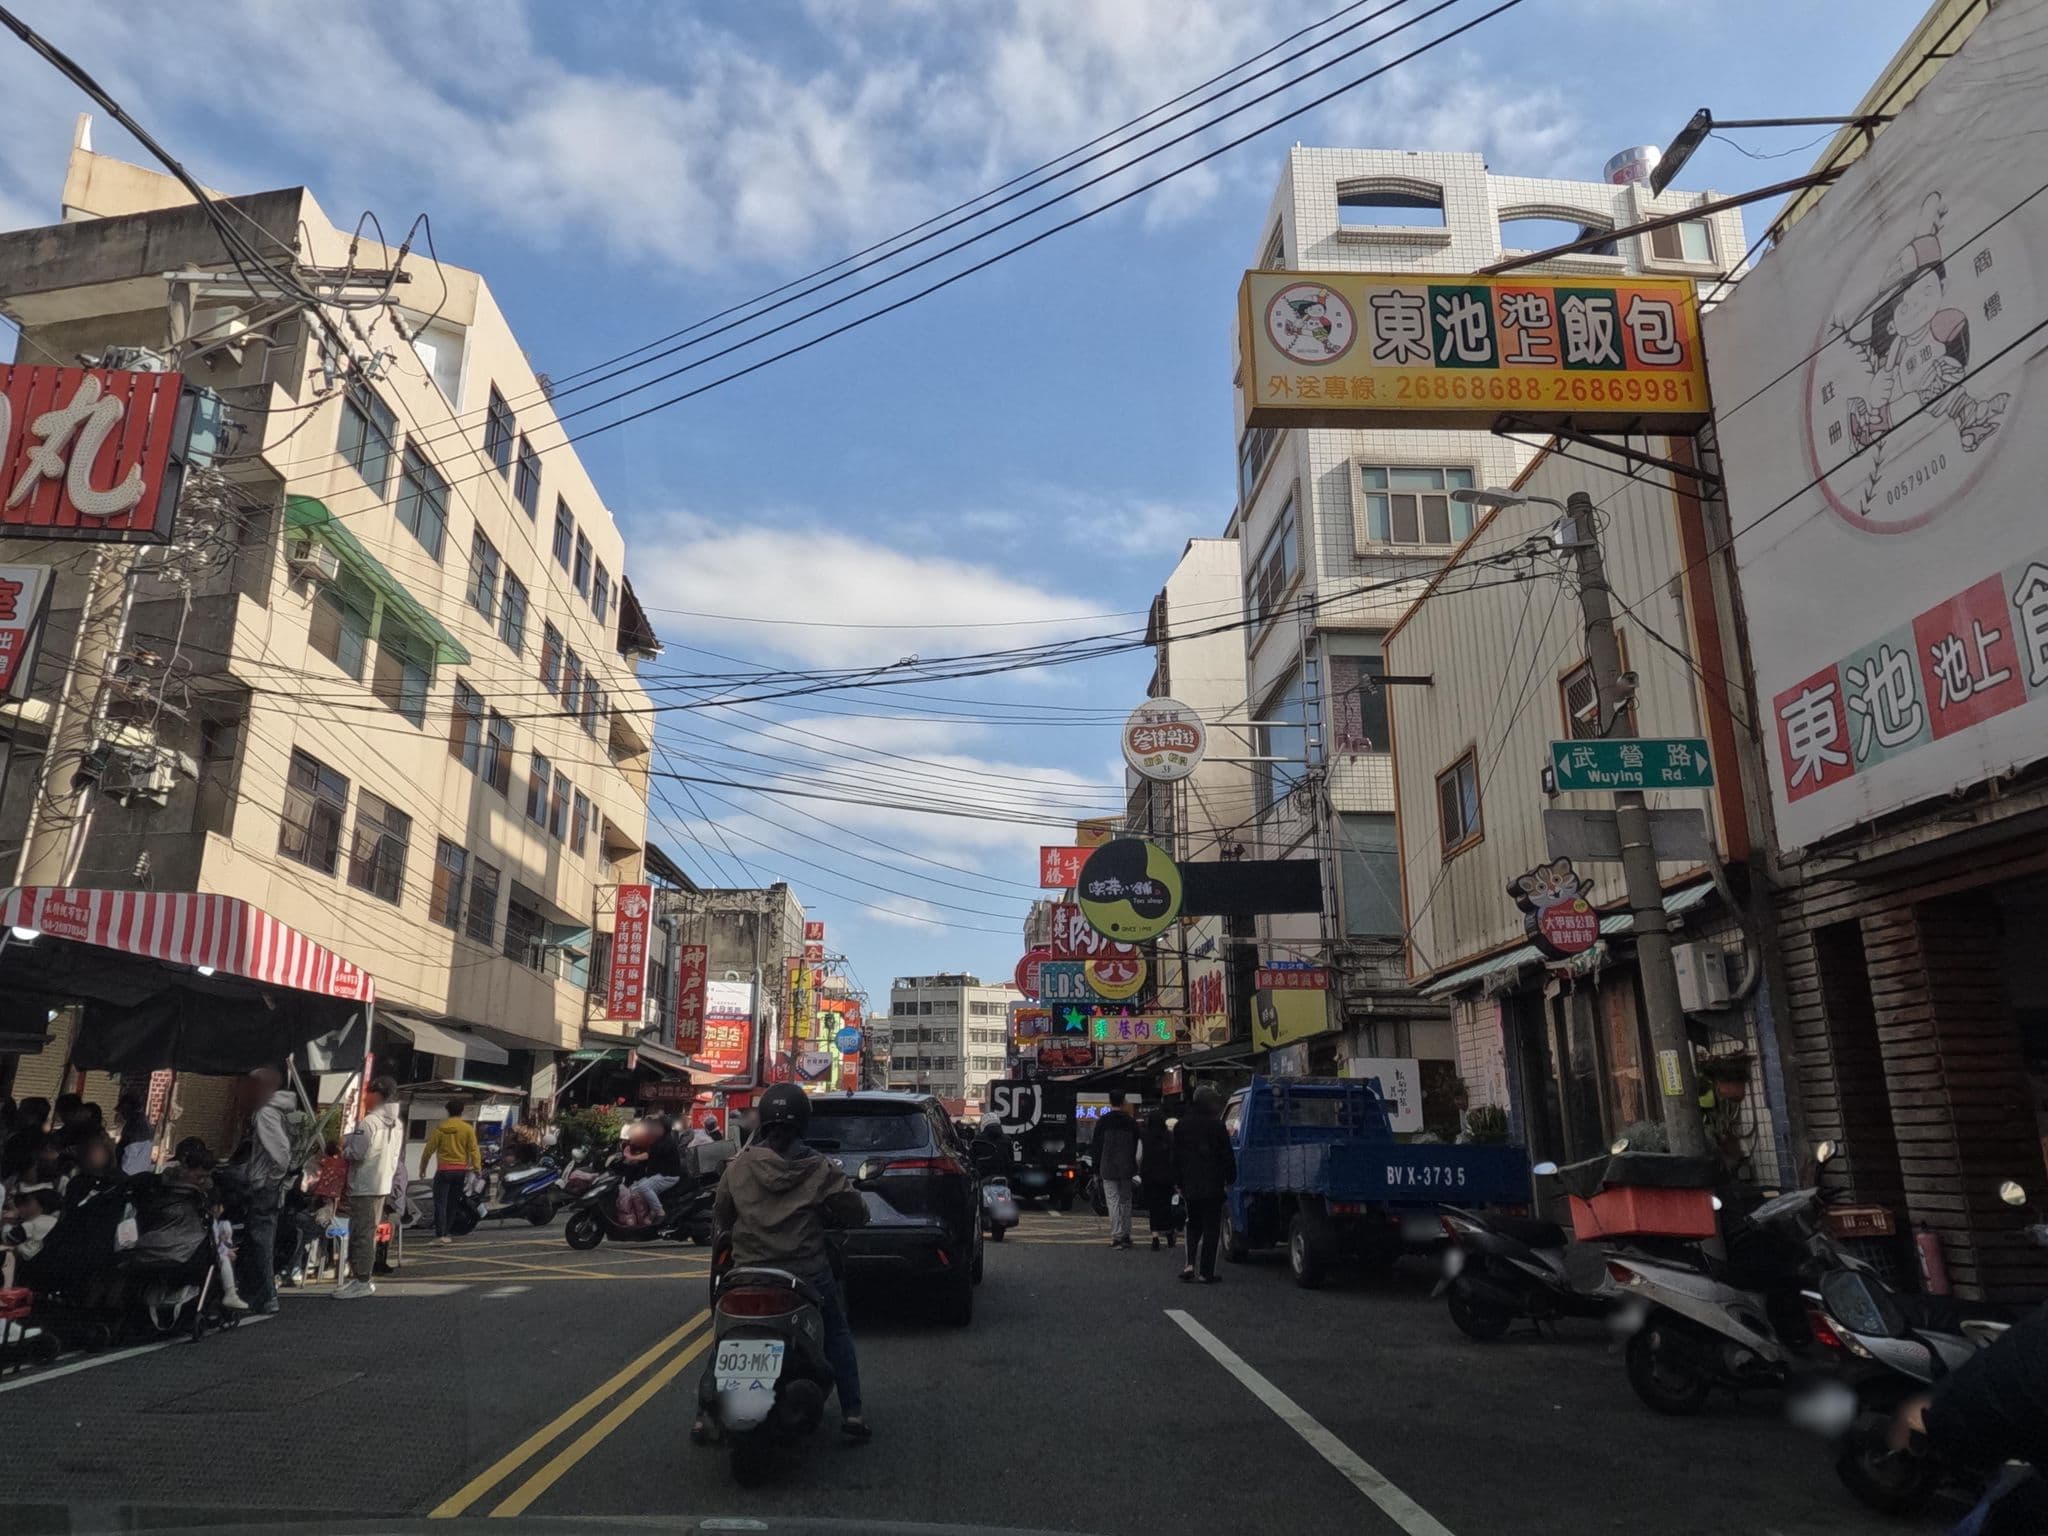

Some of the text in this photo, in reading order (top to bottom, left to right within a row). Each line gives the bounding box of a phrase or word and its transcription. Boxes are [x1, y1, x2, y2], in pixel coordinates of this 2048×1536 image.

[0, 372, 147, 518] 丸
[1886, 454, 1947, 505] 00579100
[1573, 743, 1692, 769] 武營路
[1587, 768, 1686, 785] Wuying Rd.
[718, 1352, 782, 1373] 903-MKT
